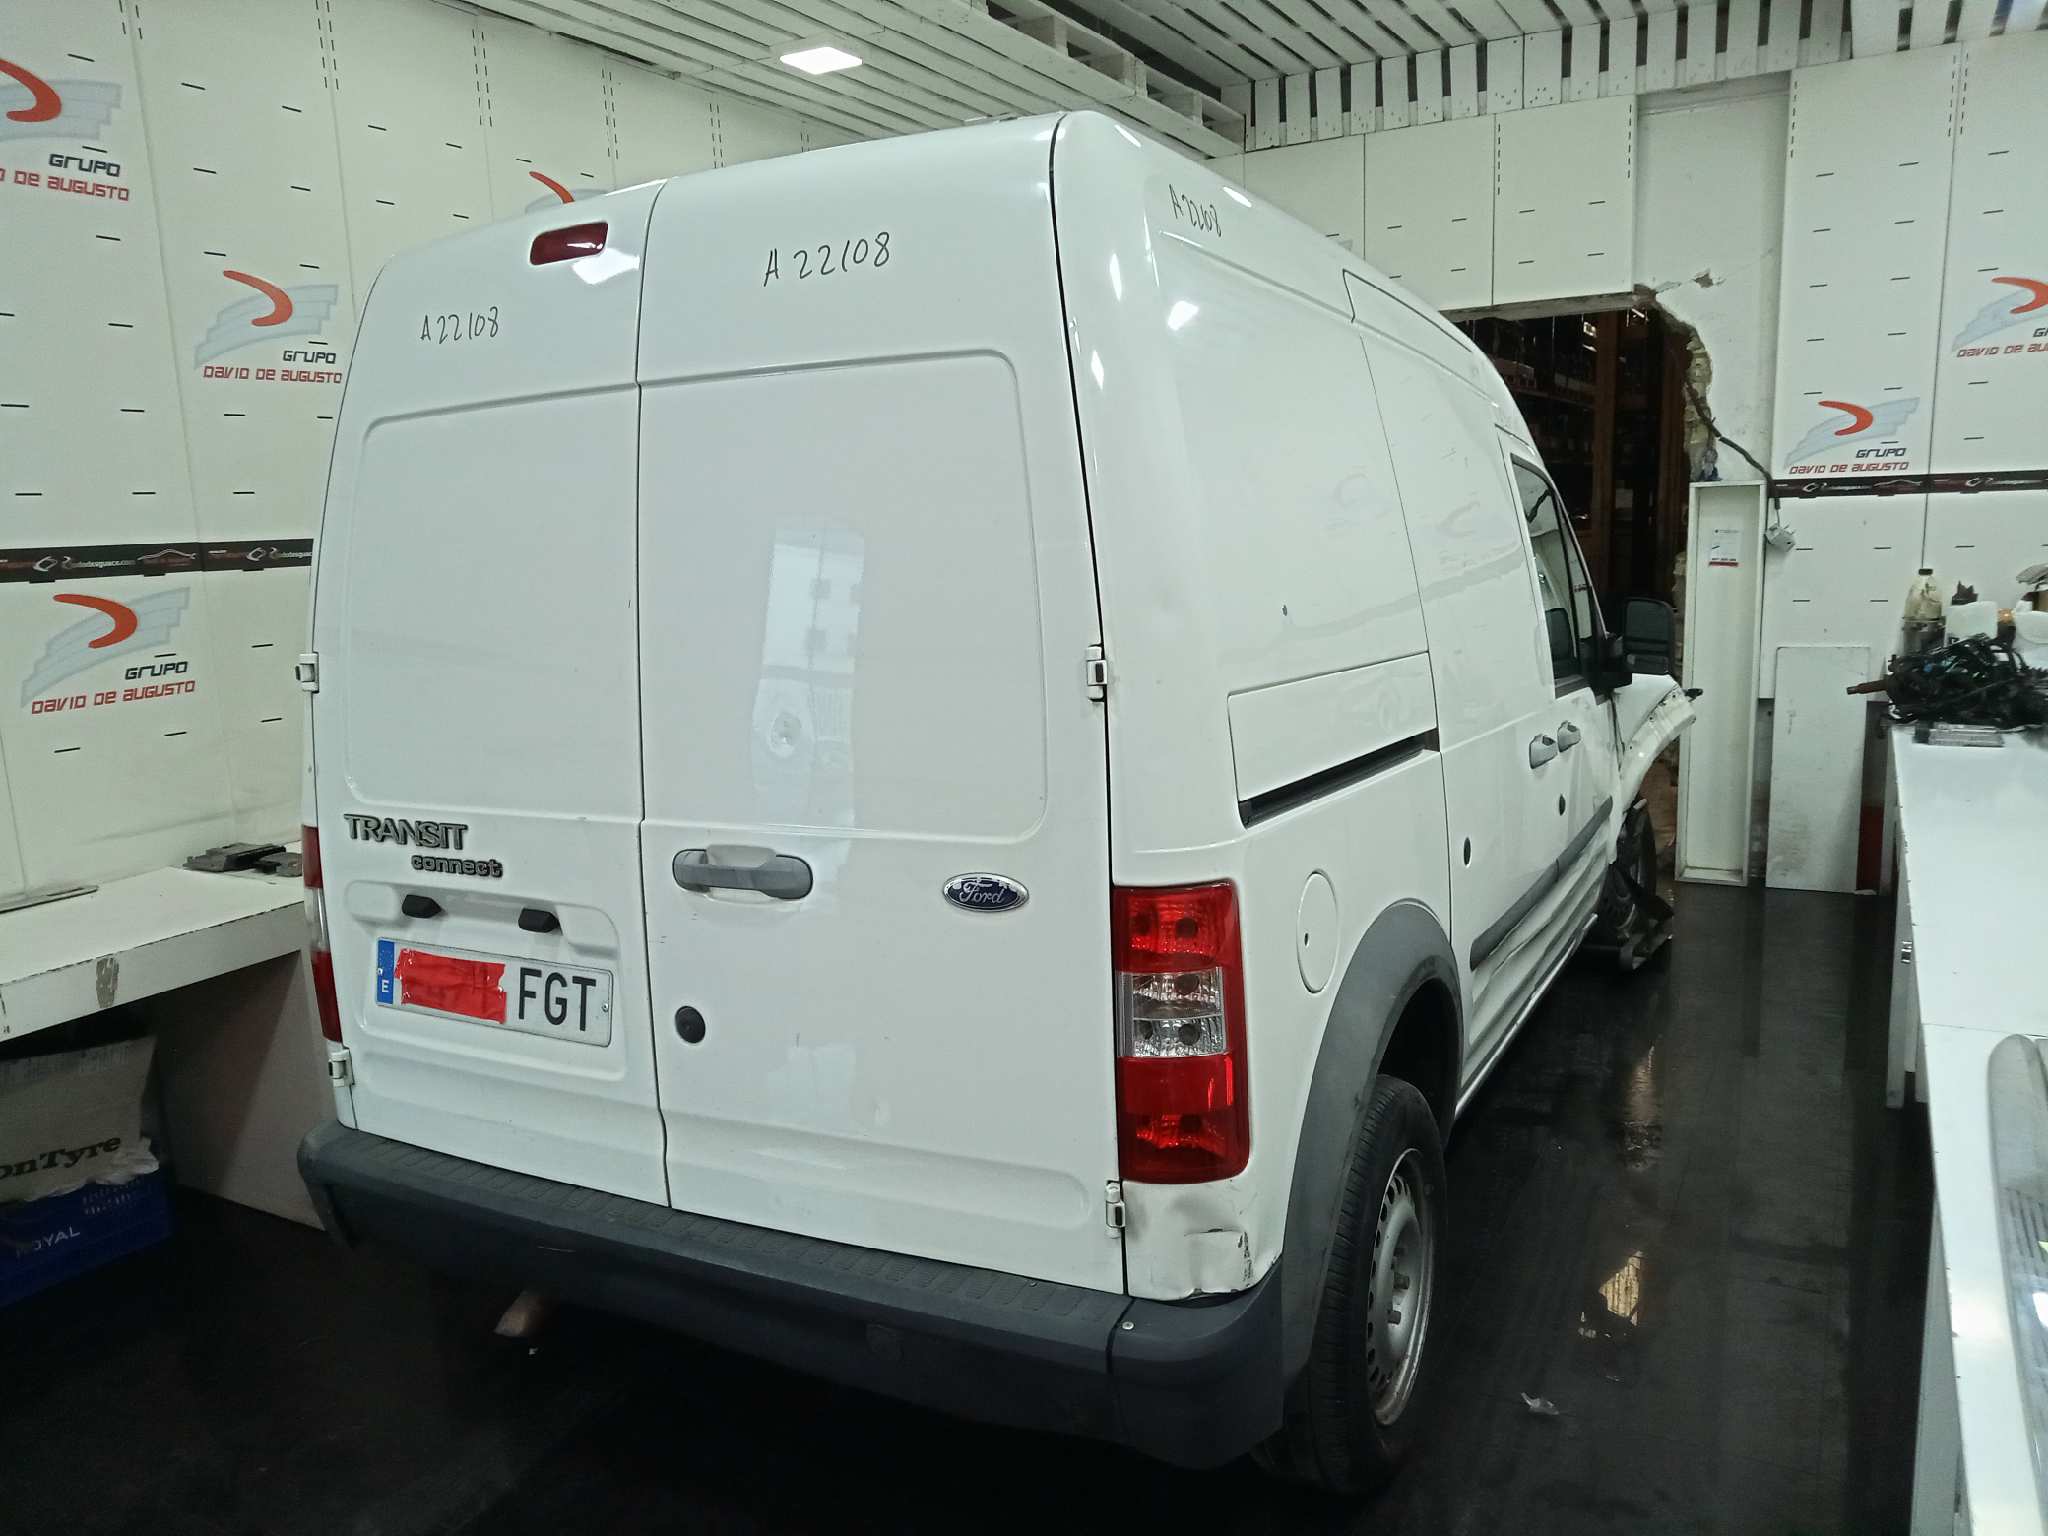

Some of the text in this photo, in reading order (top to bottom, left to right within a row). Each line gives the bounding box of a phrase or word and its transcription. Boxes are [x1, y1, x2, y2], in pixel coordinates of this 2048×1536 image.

[343, 813, 469, 850] TRANSIT
[411, 854, 504, 878] connect
[959, 881, 1005, 903] Ford
[518, 966, 597, 1032] FGT
